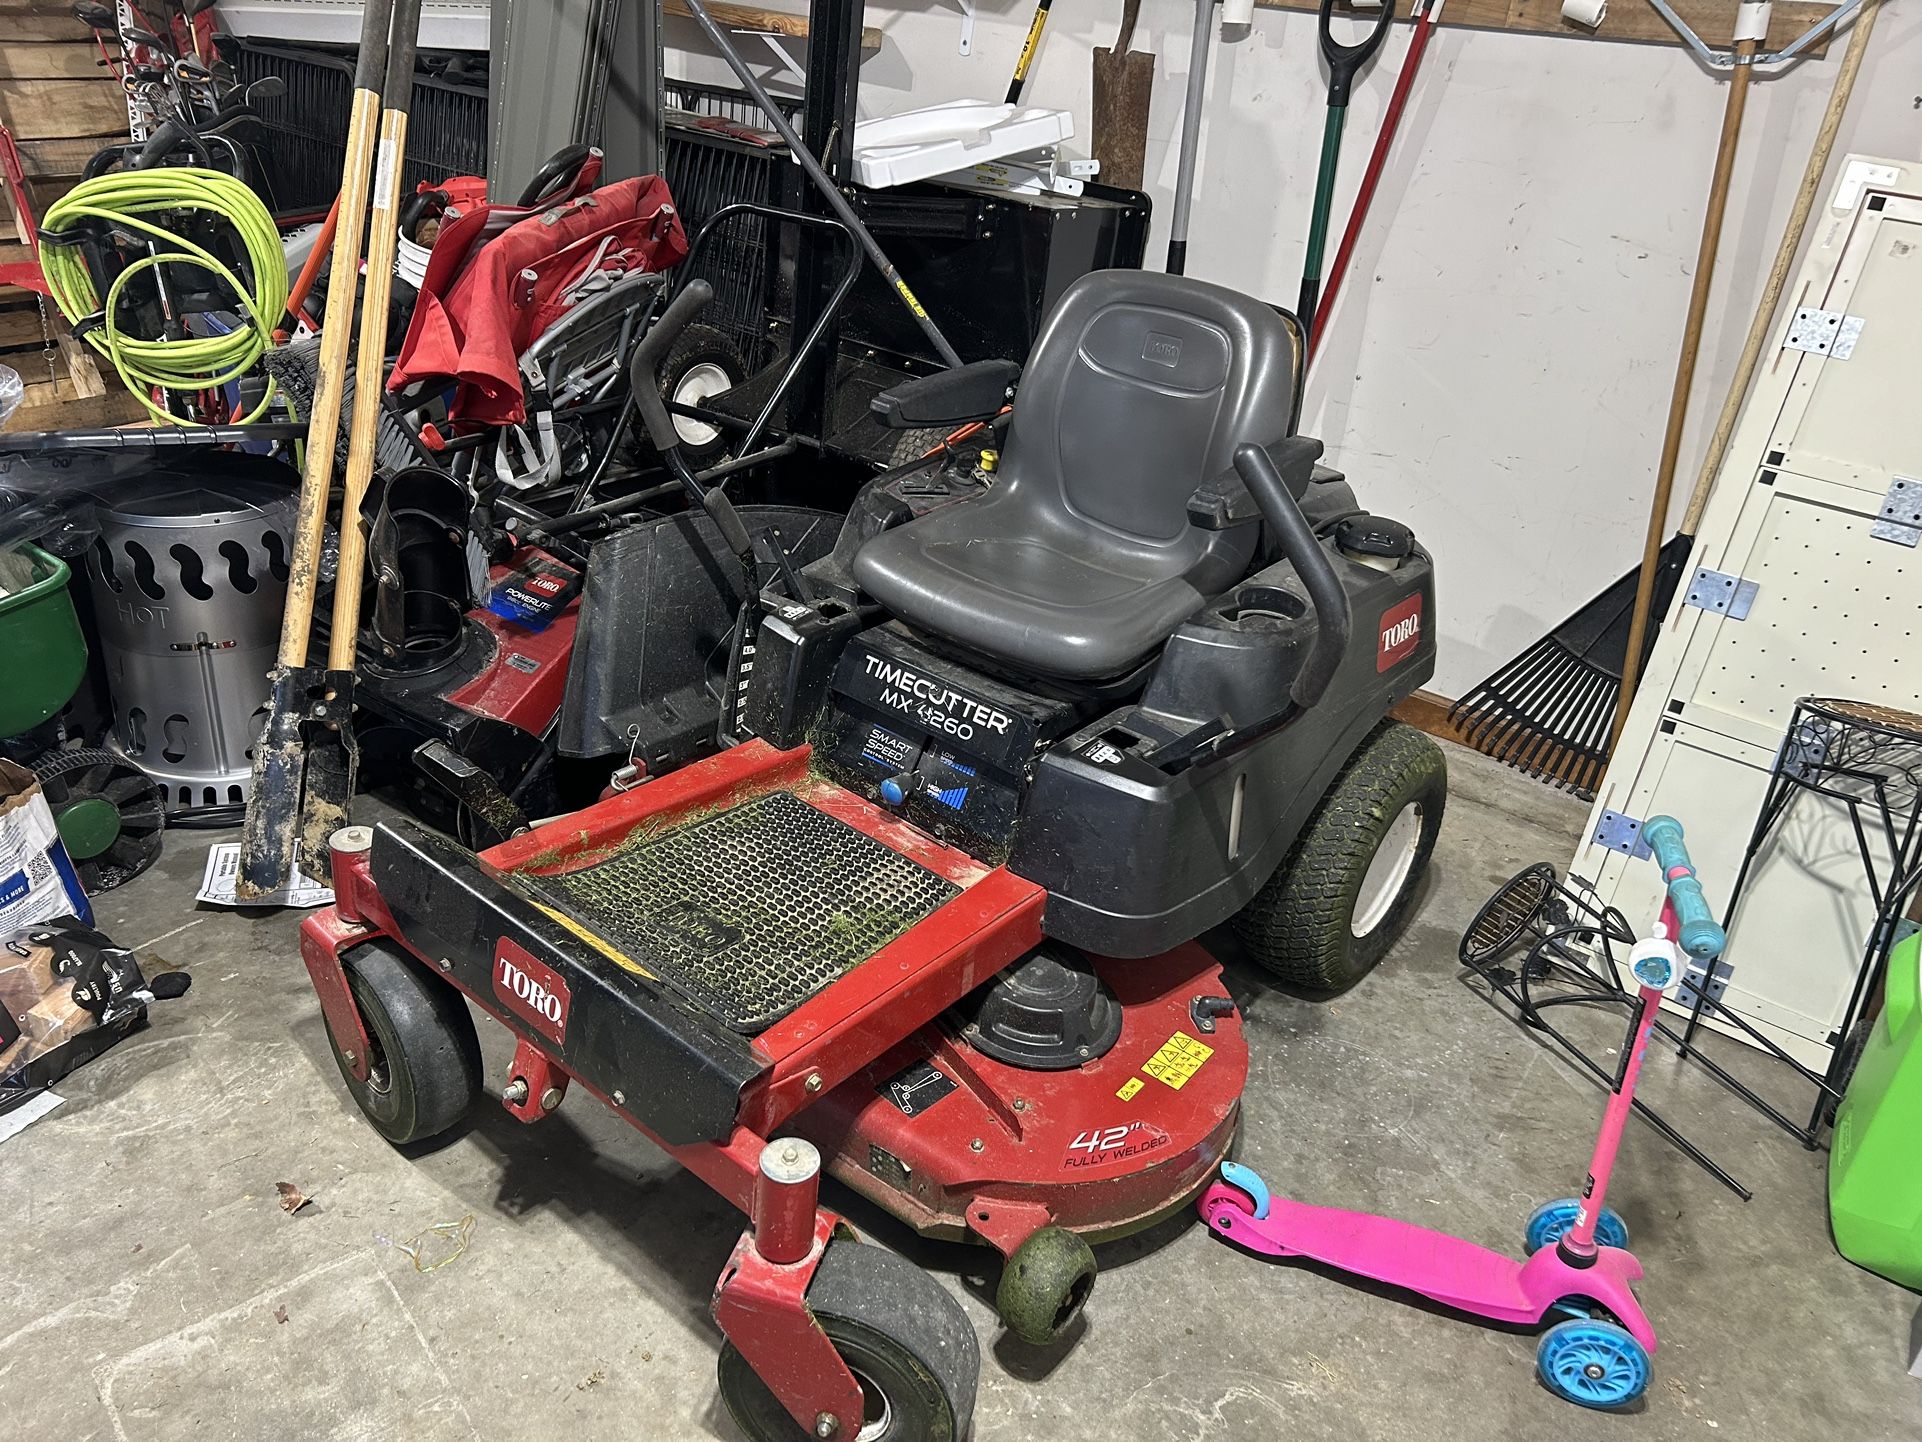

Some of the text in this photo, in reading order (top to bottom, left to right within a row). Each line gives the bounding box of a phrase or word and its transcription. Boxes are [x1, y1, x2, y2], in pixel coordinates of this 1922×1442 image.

[531, 576, 560, 592] TORO
[505, 587, 553, 611] POWERLITE
[1381, 613, 1418, 652] TORO
[865, 654, 1008, 735] TIMECUTTER
[879, 687, 914, 714] MX
[865, 738, 904, 761] SPEED
[869, 728, 913, 754] SMART
[886, 758, 905, 770] SYSTEM
[941, 750, 956, 760] LOW
[11, 886, 24, 898] MORE
[89, 981, 102, 1001] POULTRY
[499, 957, 562, 1022] TORO
[1068, 1121, 1141, 1153] 42"
[1064, 1135, 1168, 1168] FULLY WELDED
